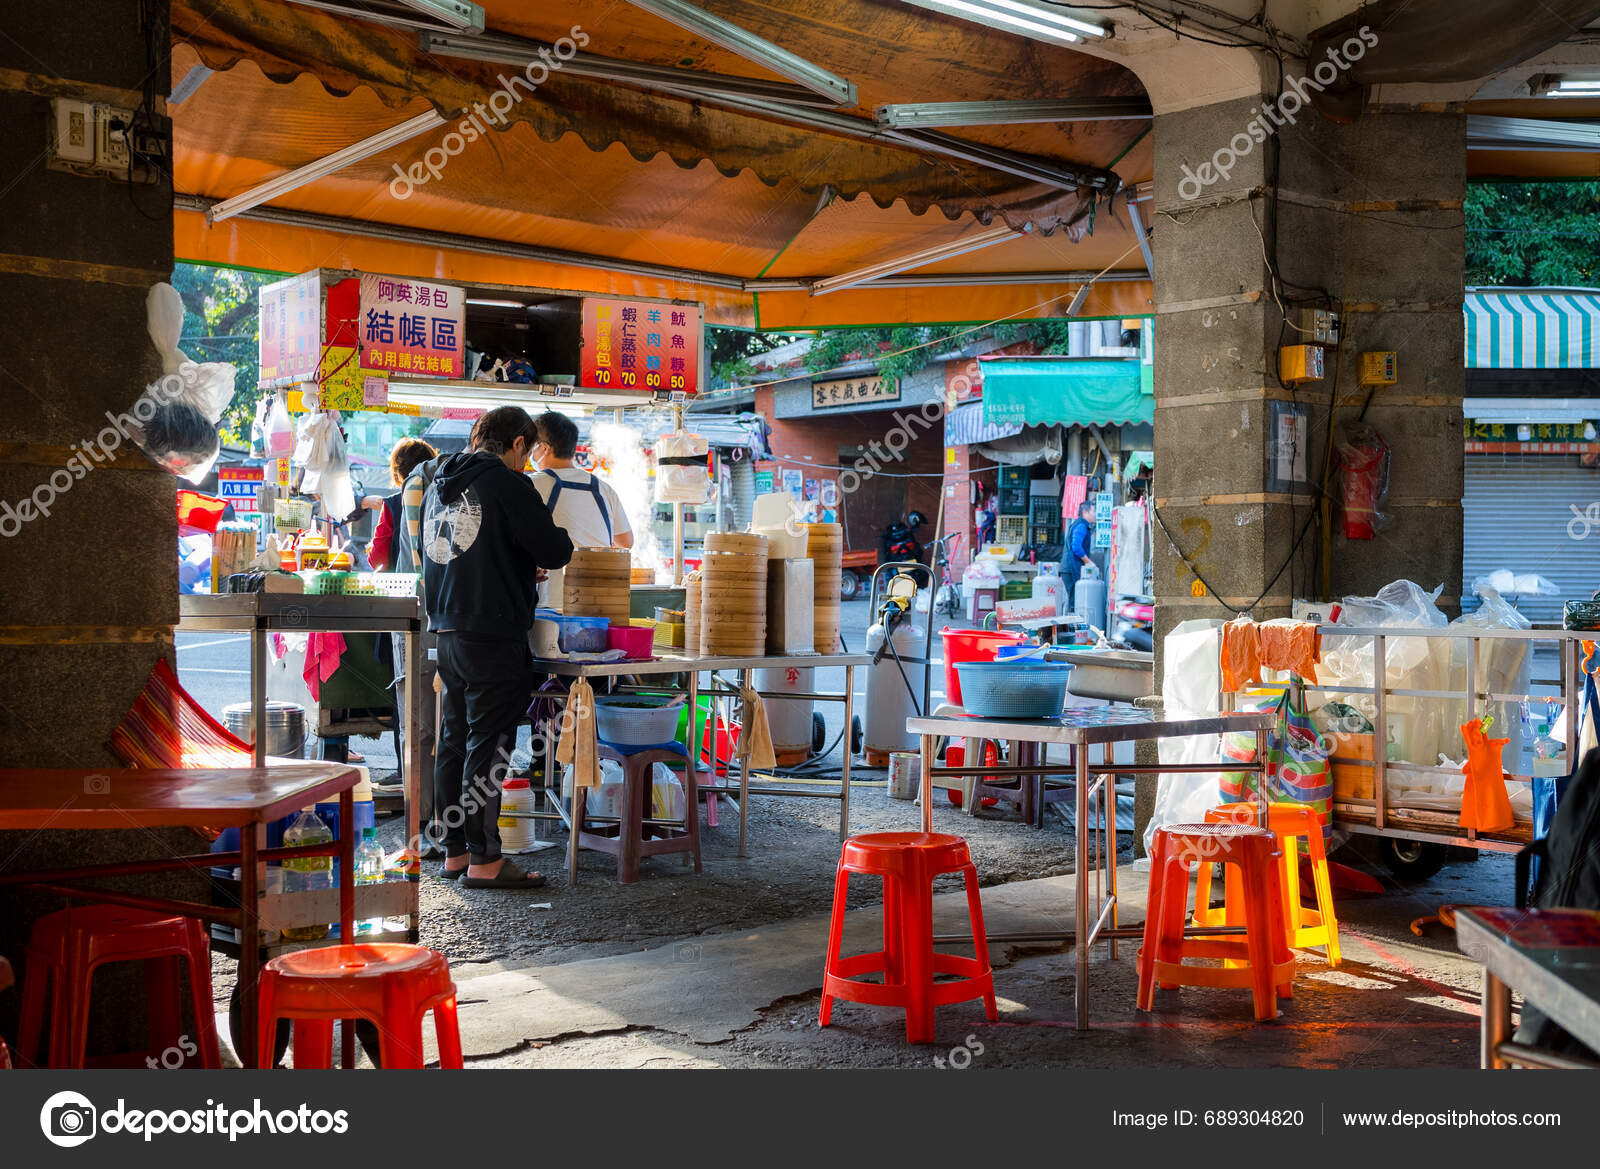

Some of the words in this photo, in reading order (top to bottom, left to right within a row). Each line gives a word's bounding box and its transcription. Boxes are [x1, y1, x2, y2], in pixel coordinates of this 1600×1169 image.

[379, 280, 448, 308] 阿英湯包
[366, 307, 457, 352] 結帳區
[596, 305, 612, 367] 鮮肉湯包
[621, 306, 637, 369] 蝦仁蒸餃
[595, 370, 611, 383] 70
[621, 372, 636, 385] 70
[646, 373, 661, 386] 60
[670, 375, 685, 389] 50
[816, 381, 896, 404] 客家戲曲公
